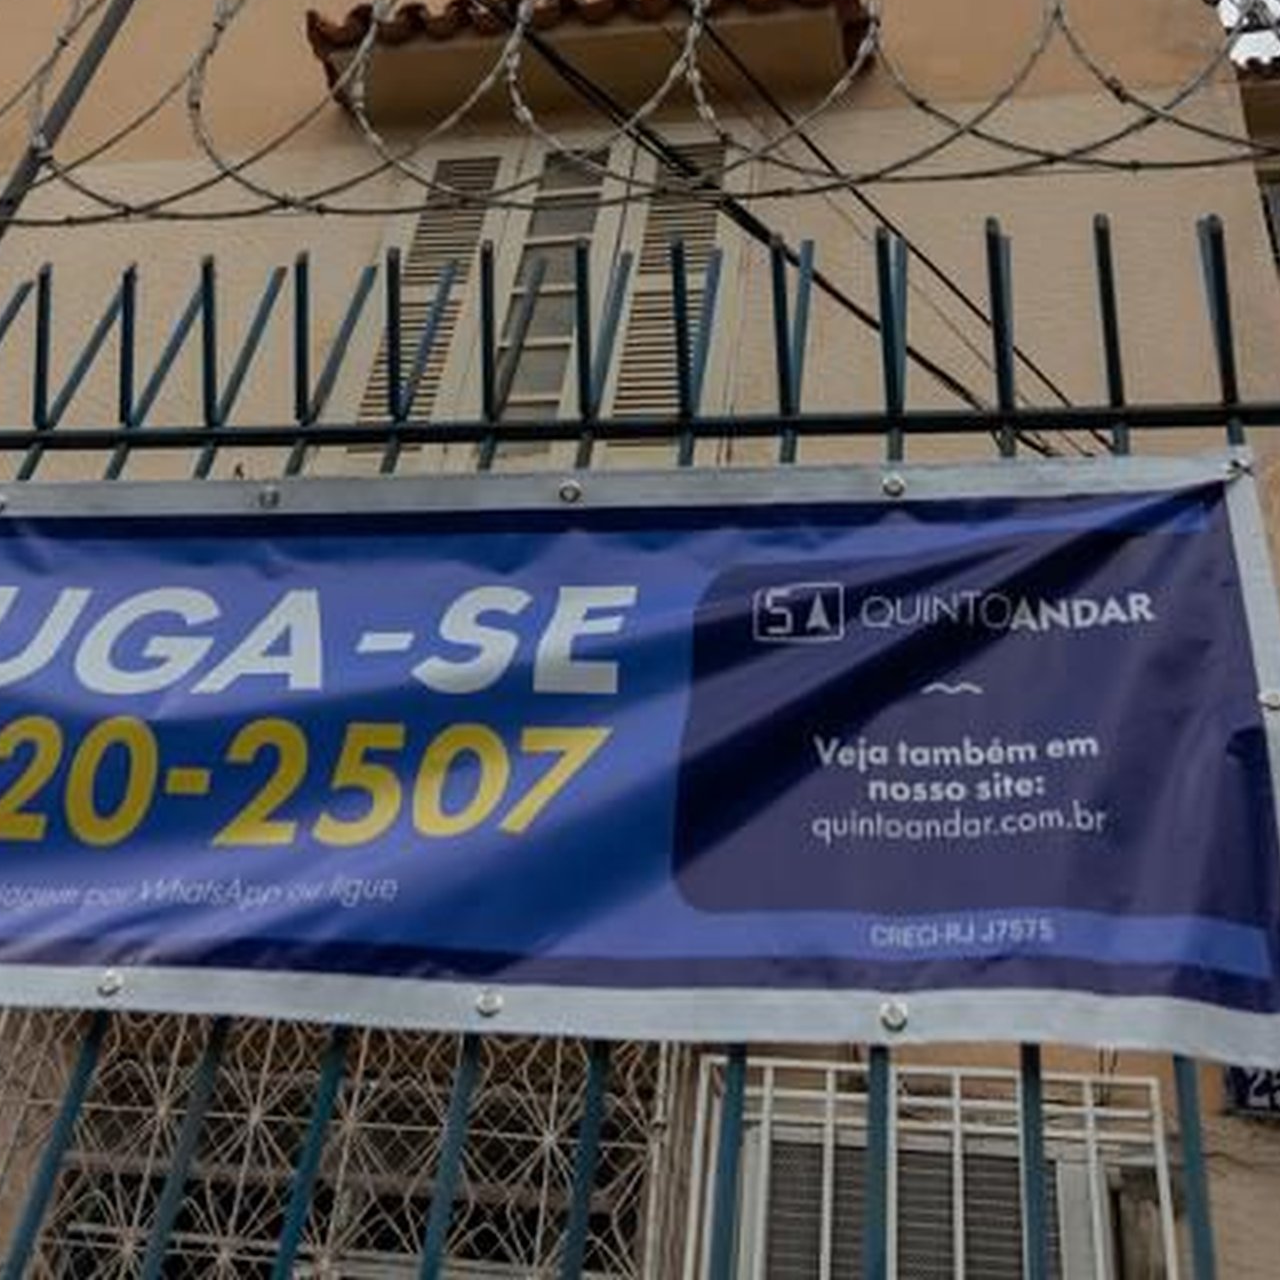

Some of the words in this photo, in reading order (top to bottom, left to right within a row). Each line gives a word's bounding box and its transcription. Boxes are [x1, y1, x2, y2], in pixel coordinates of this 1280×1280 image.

[860, 593, 1154, 632] QUINTOANDAR
[813, 736, 888, 772] Veja
[899, 739, 1037, 767] também
[1046, 736, 1100, 759] em
[868, 782, 967, 802] nosso
[811, 800, 1108, 846] quintoandar.com.br
[869, 922, 975, 949] CRECI-RJ
